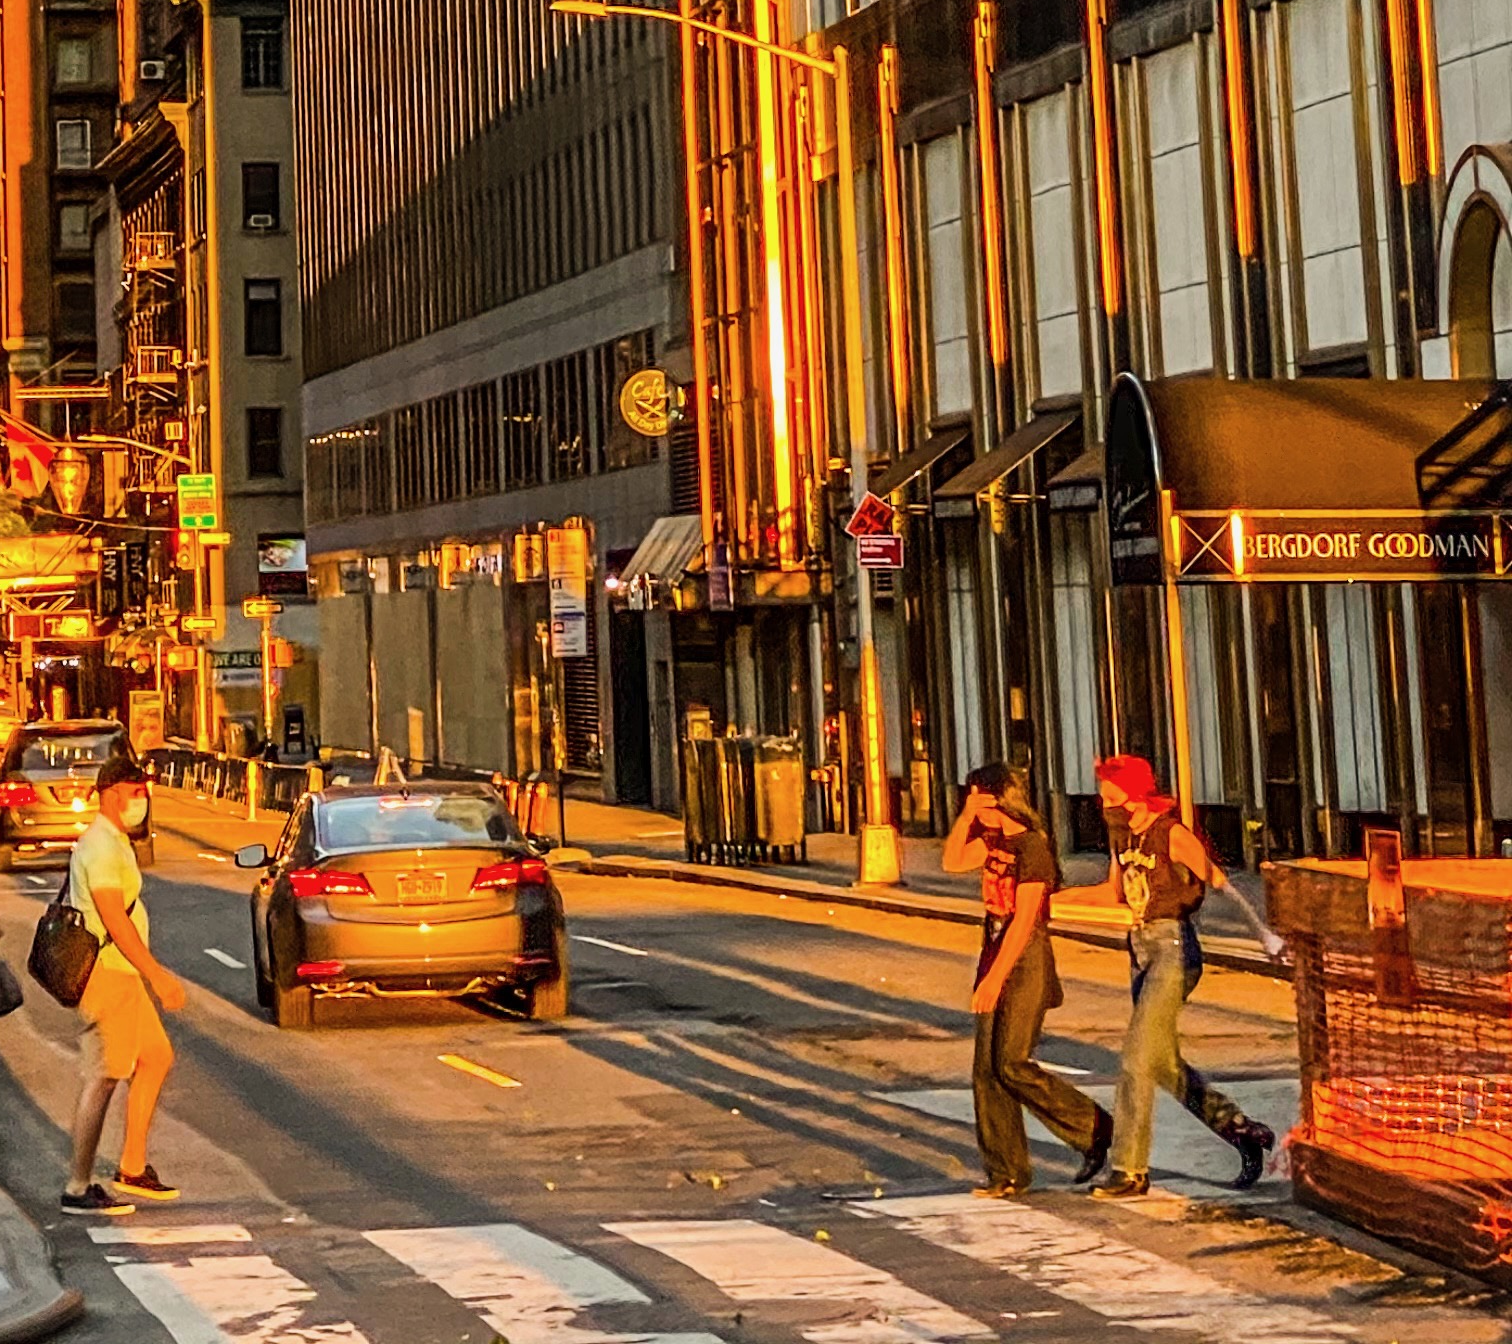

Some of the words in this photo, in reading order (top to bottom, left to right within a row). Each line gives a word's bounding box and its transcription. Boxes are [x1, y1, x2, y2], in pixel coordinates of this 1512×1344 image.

[1243, 533, 1359, 559] BERGDORF
[1368, 533, 1489, 559] GOODMAN
[232, 653, 252, 666] ARE
